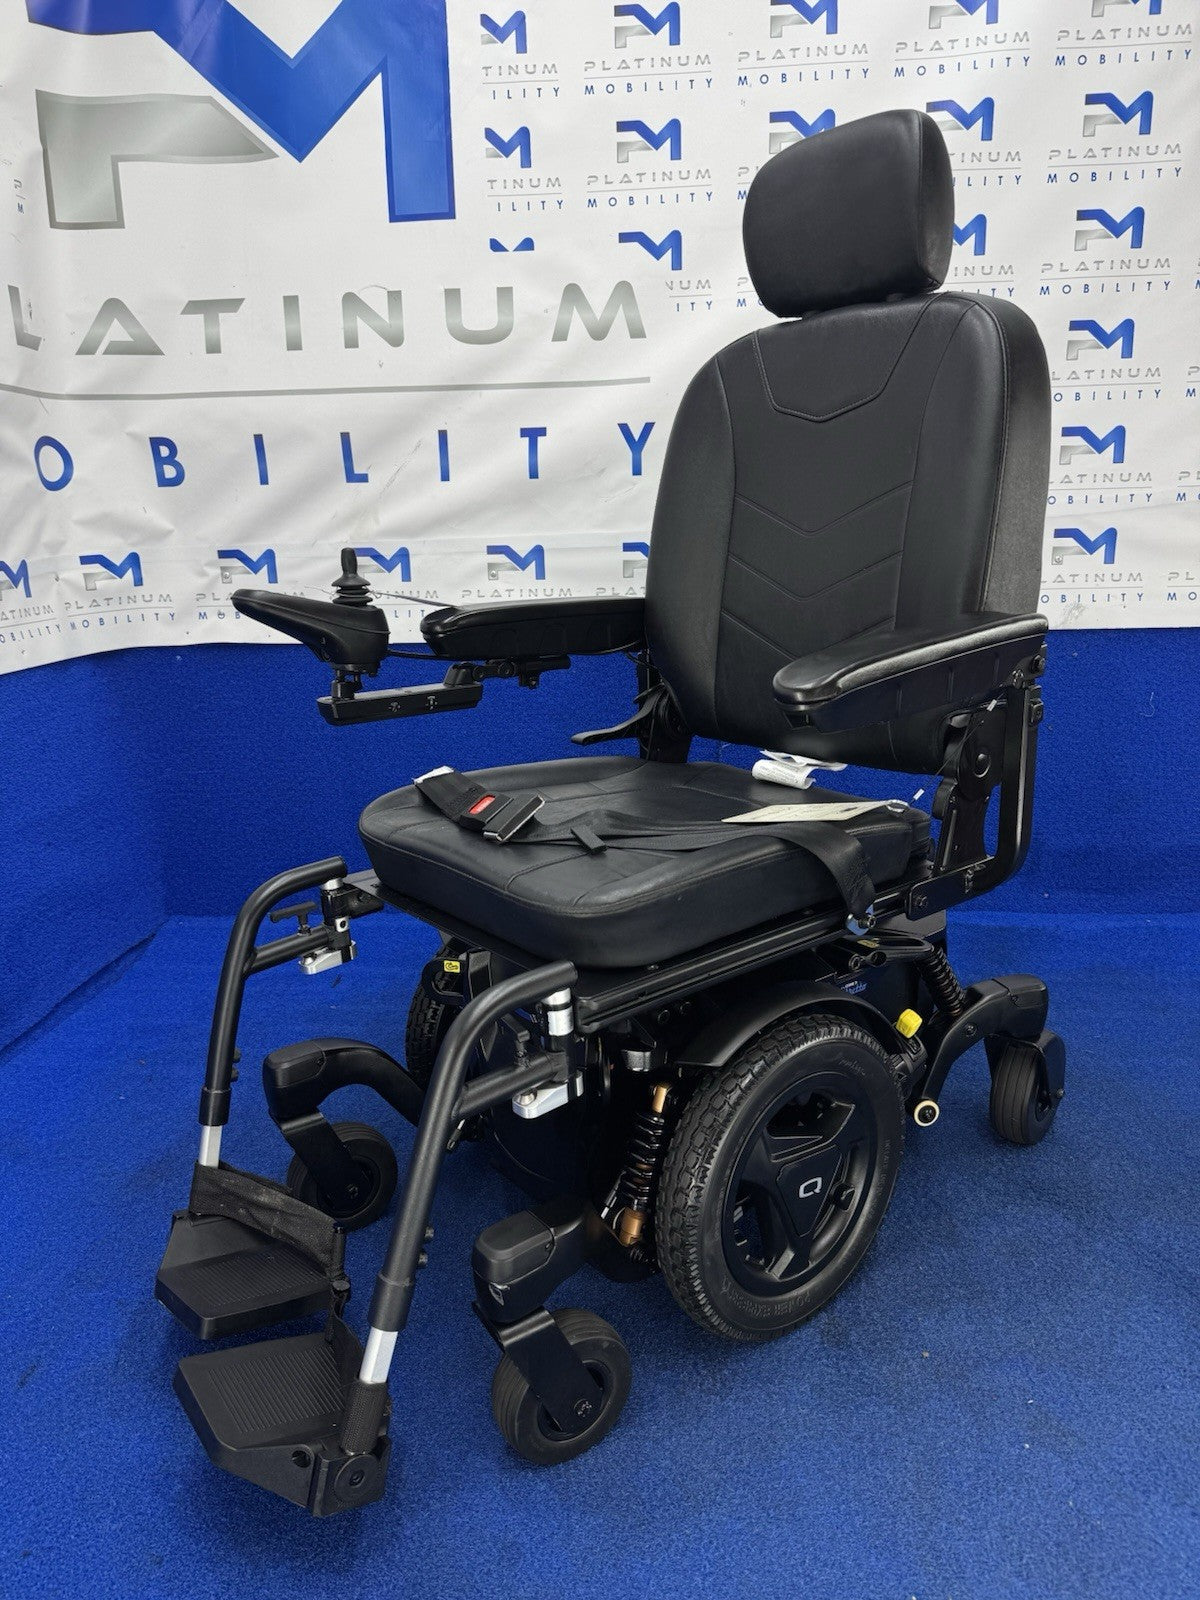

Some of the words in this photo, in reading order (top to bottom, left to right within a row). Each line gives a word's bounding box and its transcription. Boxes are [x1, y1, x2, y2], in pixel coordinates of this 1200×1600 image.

[1057, 24, 1192, 42] PLATINUM
[895, 31, 1030, 53] PLATINUM
[738, 43, 868, 62] PLATINUM
[1055, 49, 1192, 66] MOBILITY
[482, 63, 558, 77] TINUM
[584, 54, 711, 72] PLATINUM
[894, 56, 1031, 77] MOBILITY
[737, 68, 870, 86] MOBILITY
[493, 86, 560, 100] ILITY
[584, 78, 713, 96] MOBILITY
[1048, 143, 1182, 160] PLATINUM
[487, 176, 562, 190] TINUM
[587, 168, 711, 186] PLATINUM
[952, 175, 1022, 187] ILITY
[1047, 166, 1182, 184] MOBILITY
[497, 200, 563, 212] ILITY
[587, 191, 713, 208] MOBILITY
[954, 263, 1015, 277] INUM
[1040, 257, 1171, 274] PLATINUM
[1039, 280, 1171, 296] MOBILITY
[8, 281, 647, 355] LATINUM
[1052, 367, 1161, 381] LATINUM
[1053, 389, 1161, 402] OBILITY
[34, 422, 655, 491] OBILITY
[1049, 471, 1152, 484] ATINUM
[1047, 493, 1152, 505] OBILITY
[1041, 572, 1143, 583] ATINUM
[64, 593, 173, 610] PLATINUM
[461, 587, 573, 599] PLATINUM
[1041, 592, 1144, 604] OBILITY
[1, 604, 54, 621] ATINUM
[69, 612, 176, 631] MOBILITY
[0, 624, 62, 643] OBILITY
